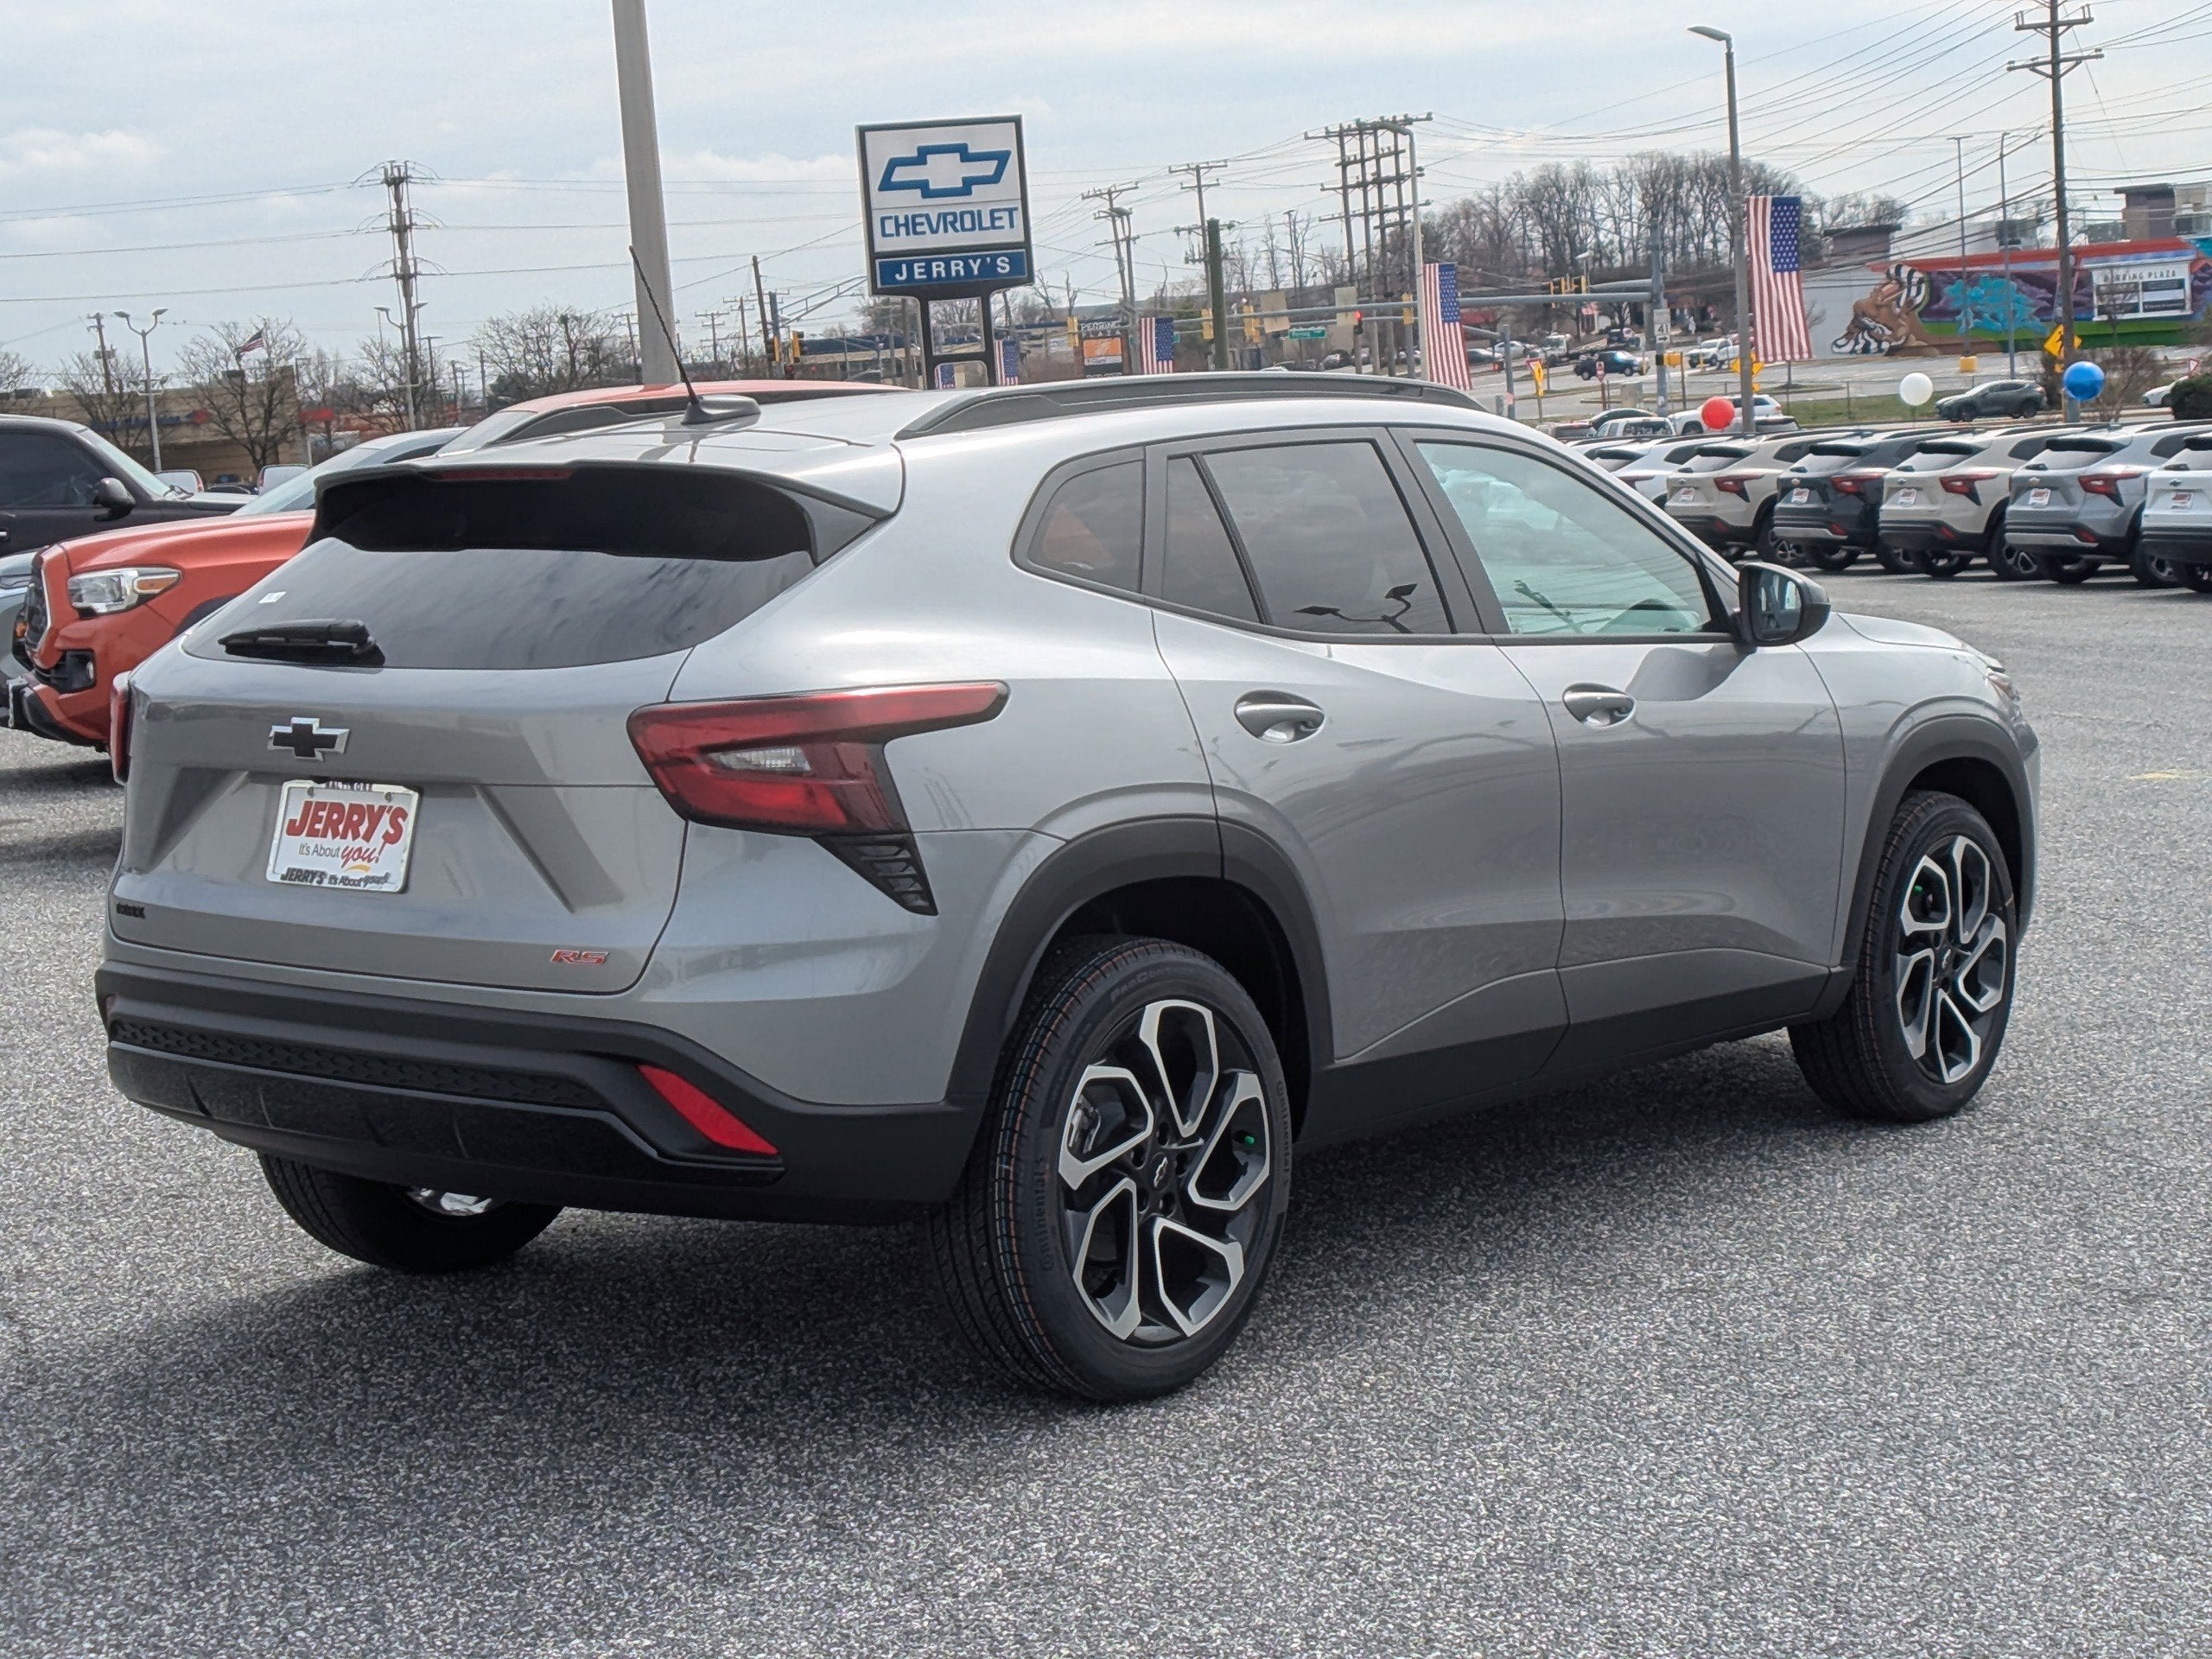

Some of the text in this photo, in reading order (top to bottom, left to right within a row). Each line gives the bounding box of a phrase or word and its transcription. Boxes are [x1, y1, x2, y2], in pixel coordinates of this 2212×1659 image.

[880, 207, 1018, 238] CHEVROLET
[895, 257, 1010, 281] JERRY'S
[2147, 269, 2177, 279] PLAZA
[286, 800, 408, 844] JERRY'S
[299, 841, 387, 868] It's About you!
[280, 867, 327, 885] JERRY'S
[550, 950, 609, 965] RS
